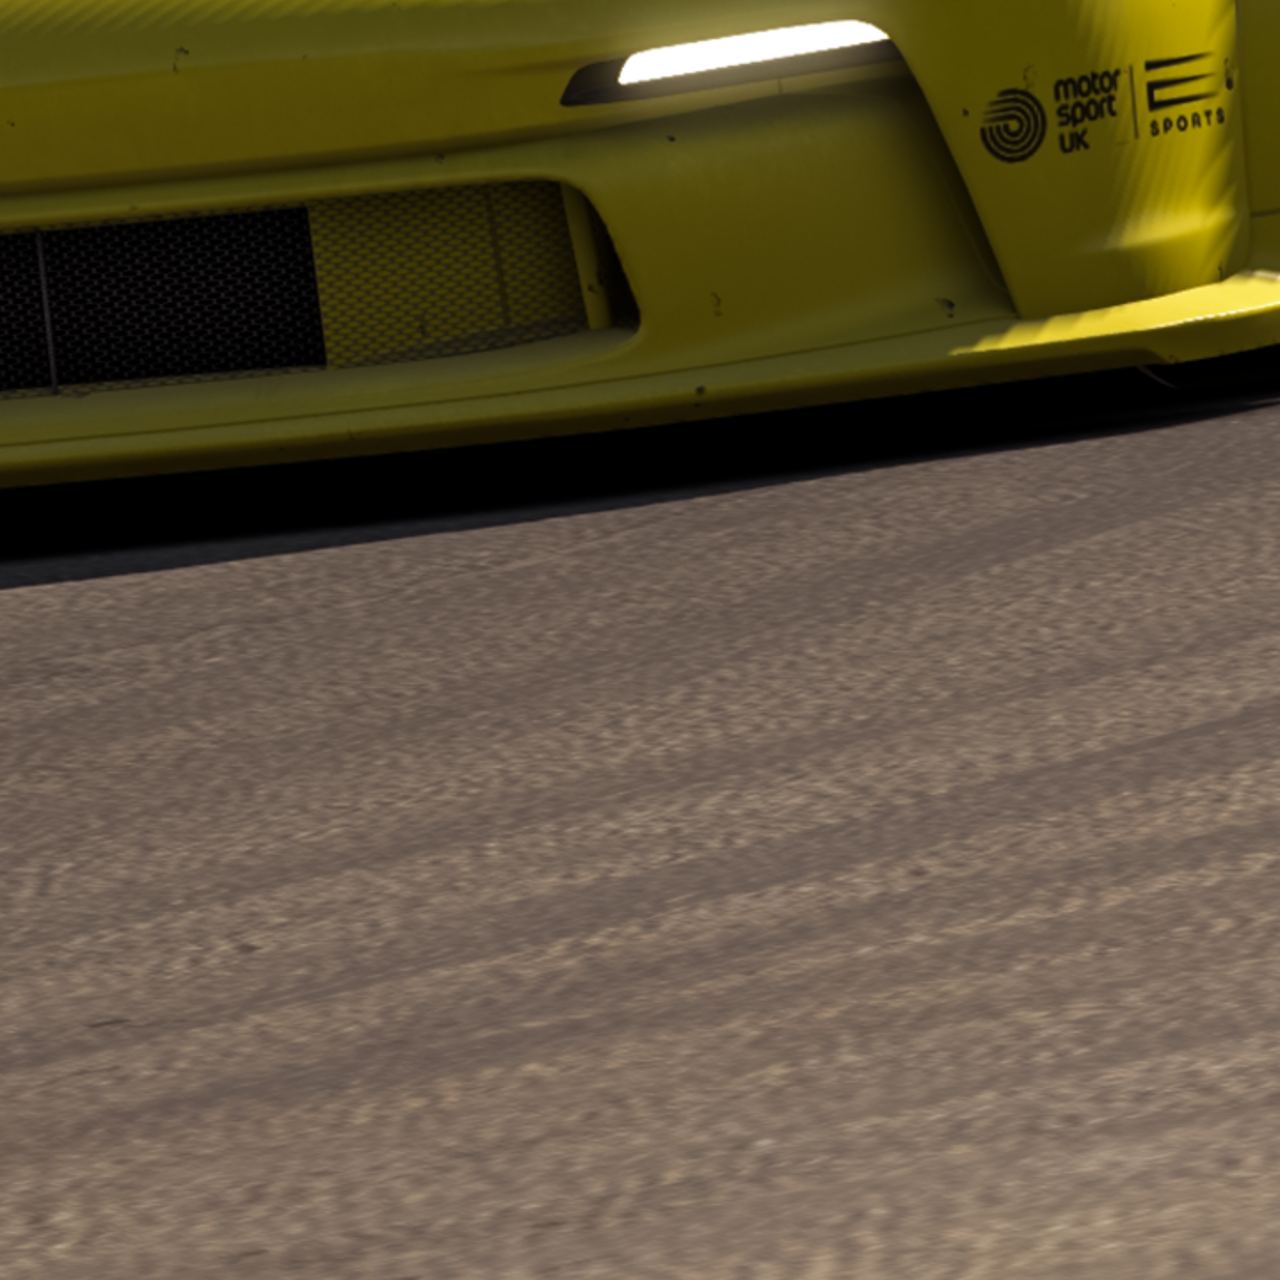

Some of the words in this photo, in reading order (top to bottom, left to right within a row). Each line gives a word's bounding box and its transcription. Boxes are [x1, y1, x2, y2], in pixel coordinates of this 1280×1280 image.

[1054, 69, 1121, 102] motor
[1056, 95, 1117, 128] sport
[1150, 107, 1225, 137] SPORTS
[1059, 128, 1090, 154] UK
